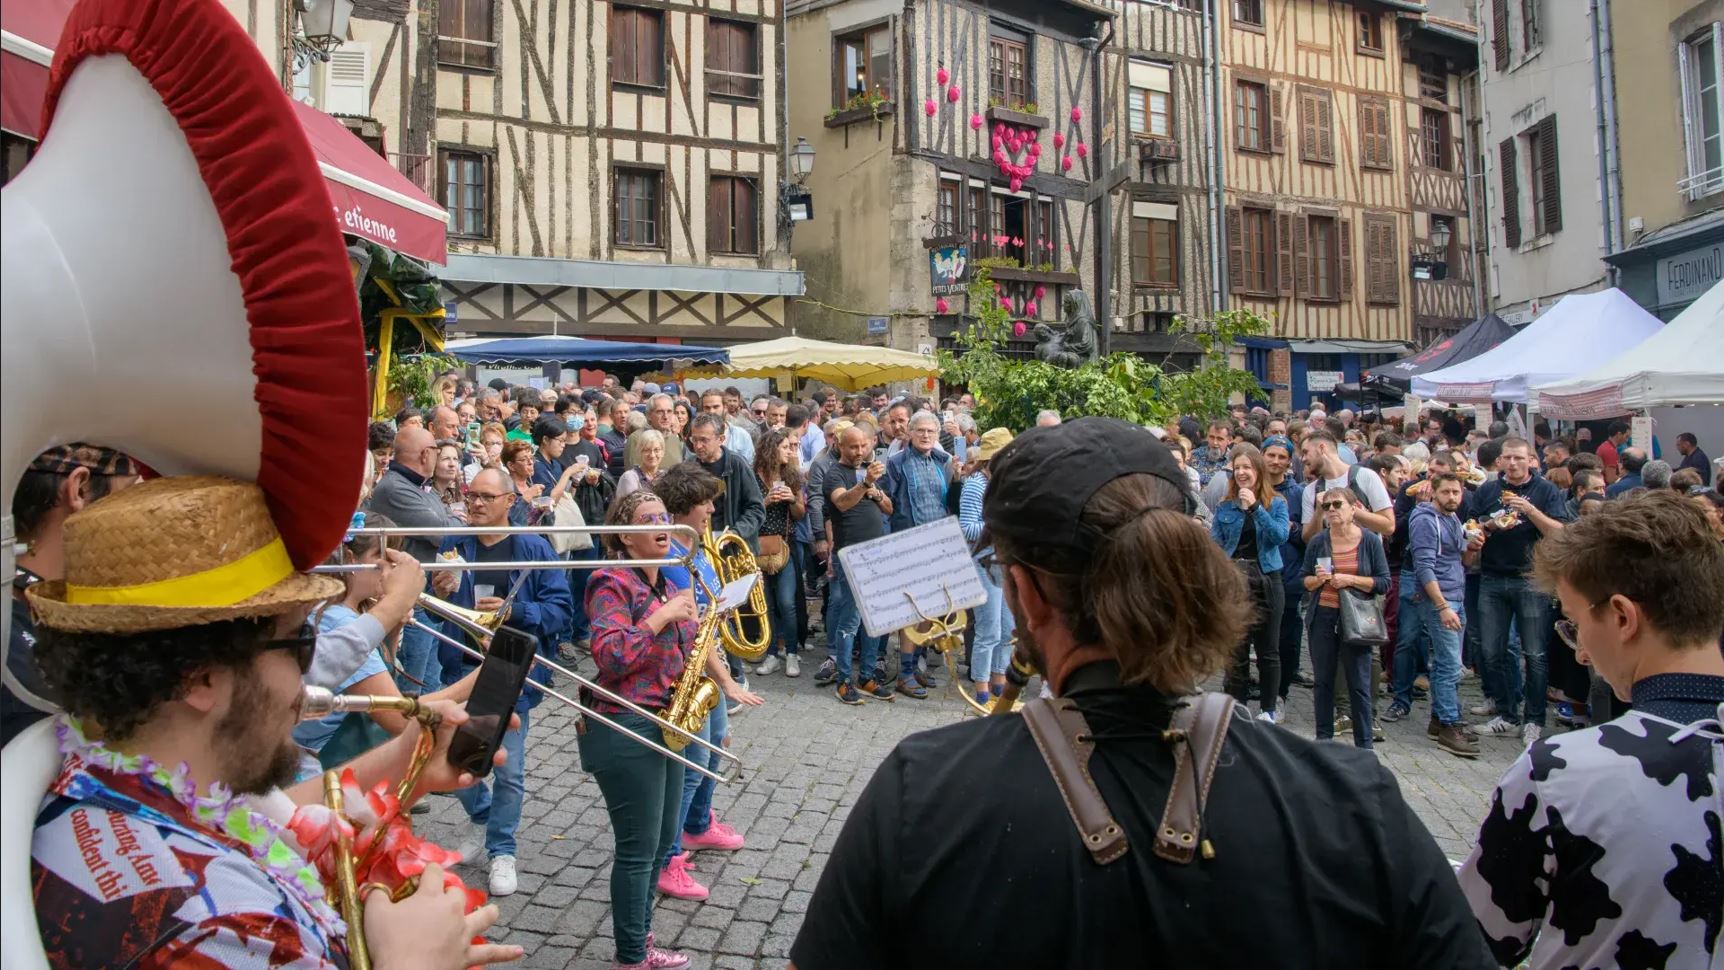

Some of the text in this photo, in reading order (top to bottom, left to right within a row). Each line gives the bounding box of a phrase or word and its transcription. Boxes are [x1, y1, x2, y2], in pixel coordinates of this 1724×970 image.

[345, 205, 397, 243] etienne
[1667, 247, 1722, 291] FERDINAND
[71, 808, 111, 874] confident
